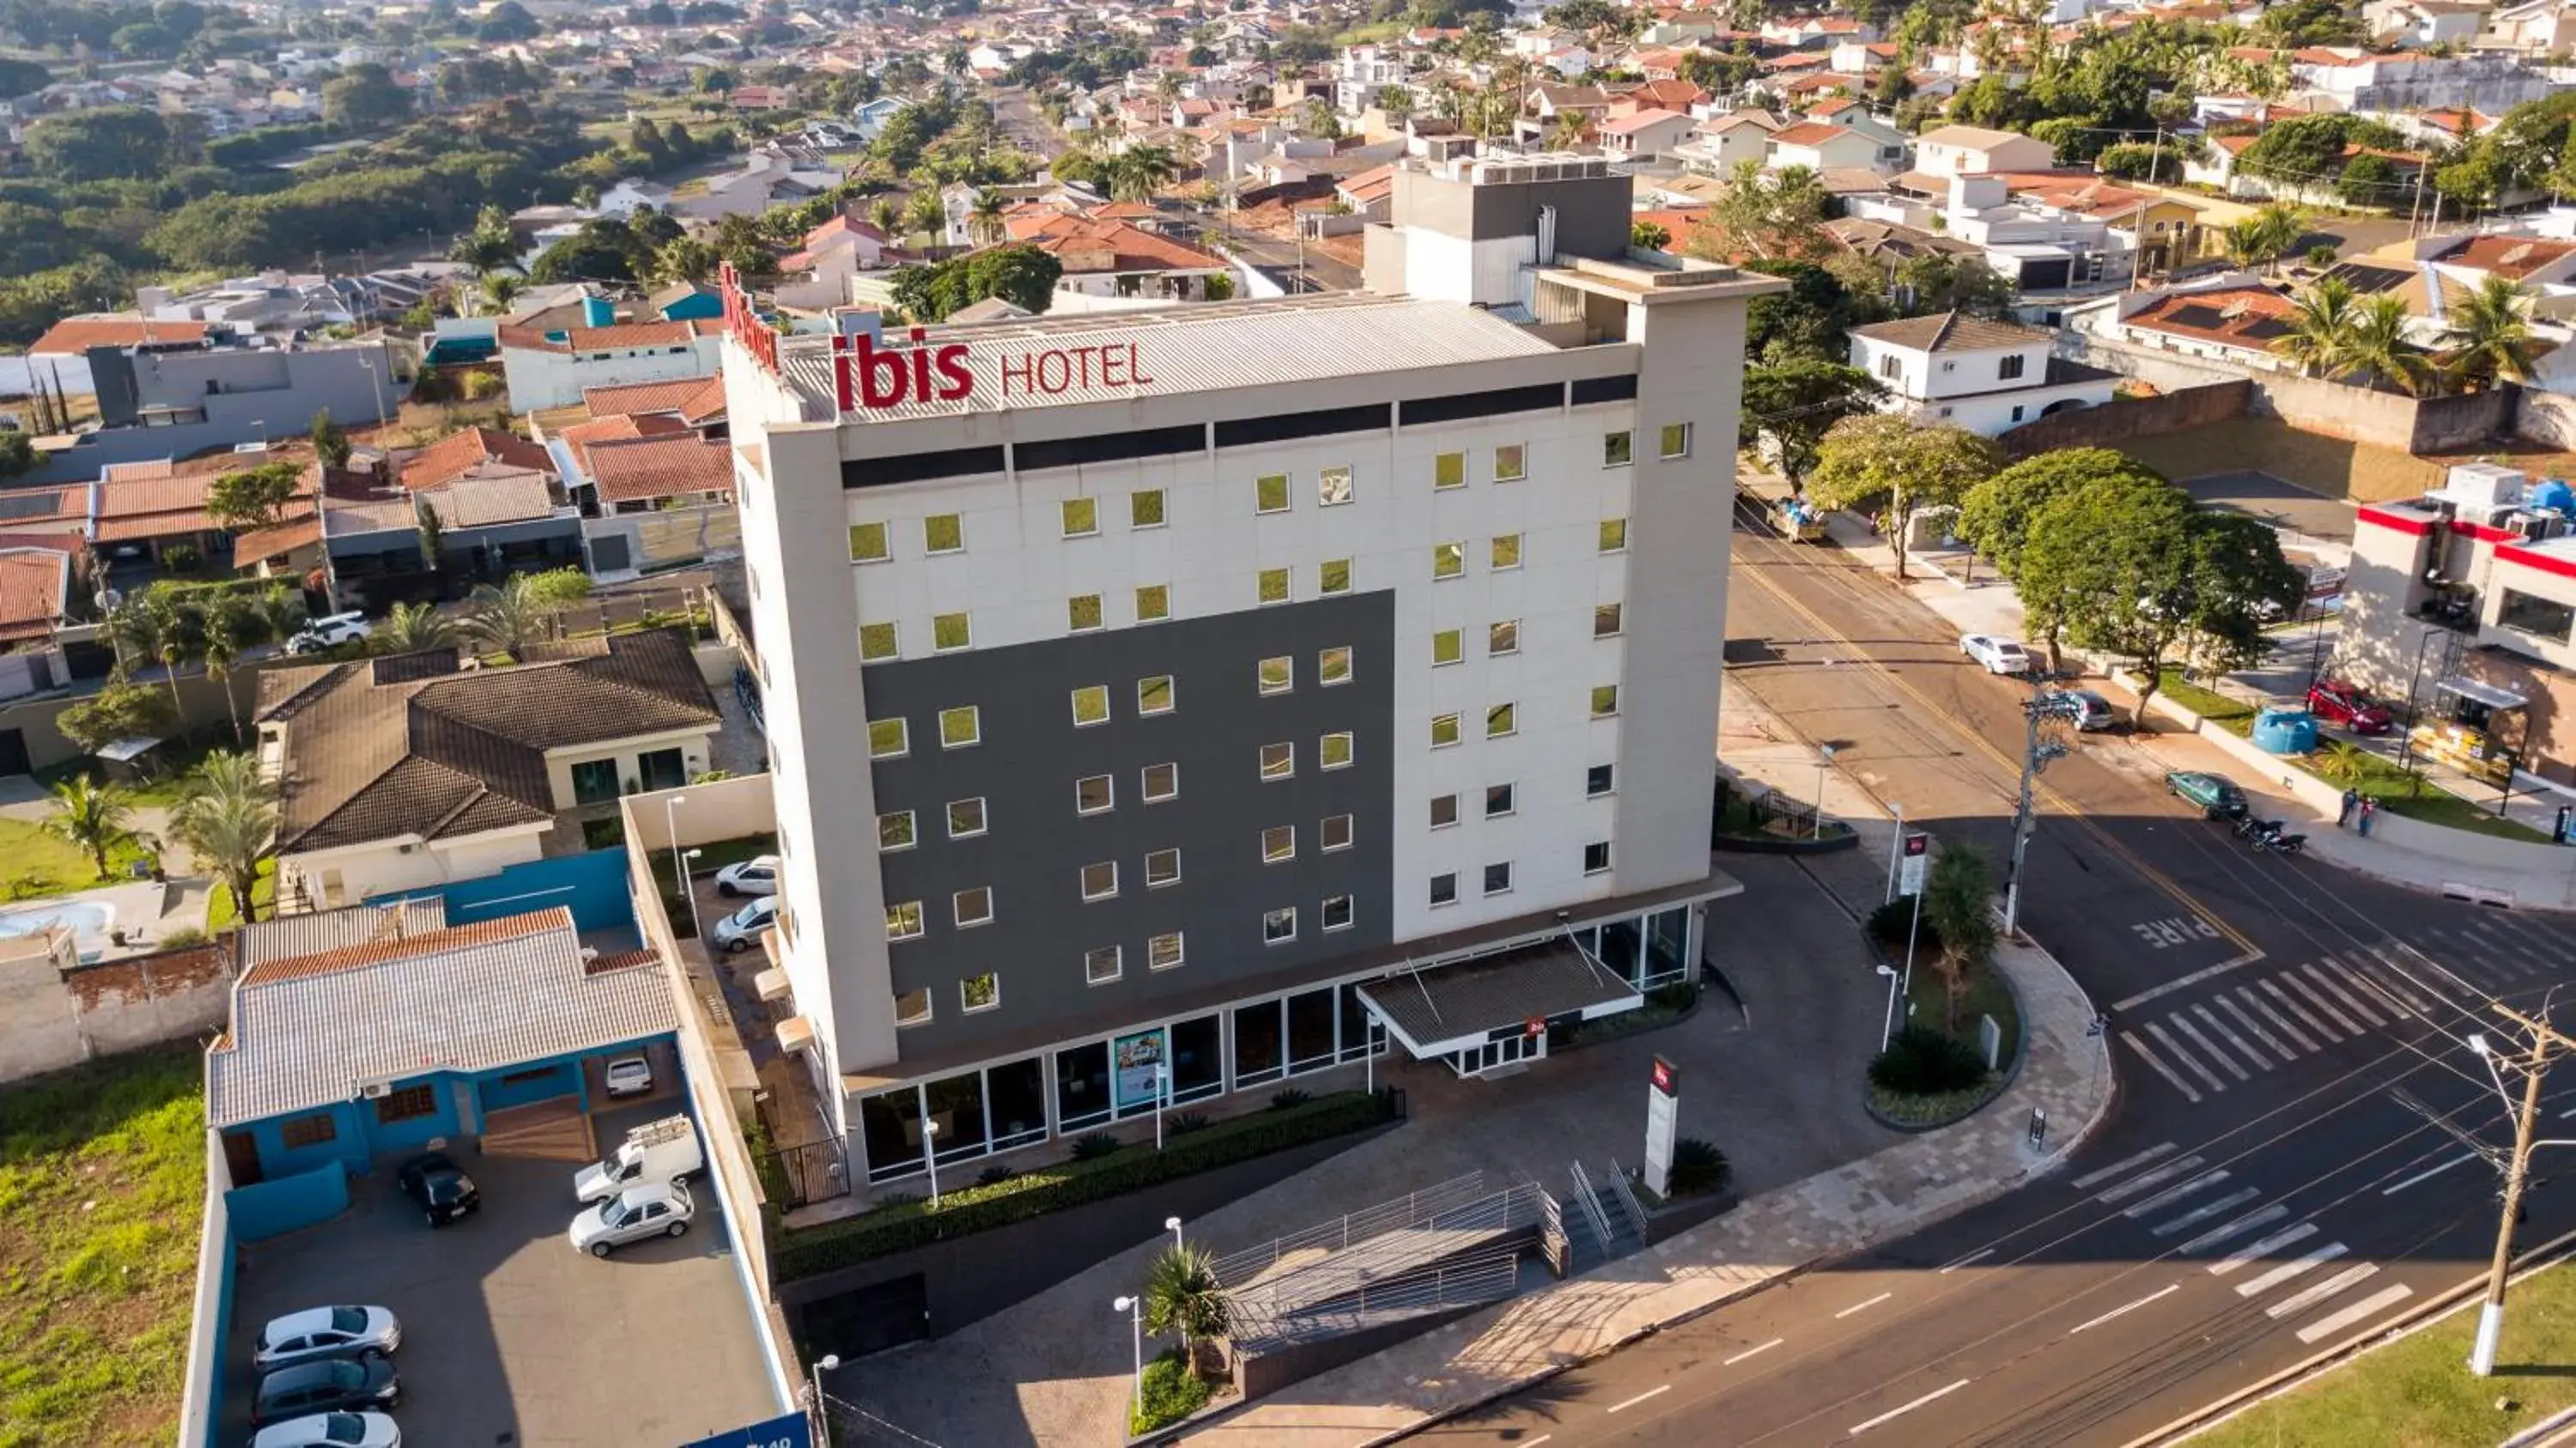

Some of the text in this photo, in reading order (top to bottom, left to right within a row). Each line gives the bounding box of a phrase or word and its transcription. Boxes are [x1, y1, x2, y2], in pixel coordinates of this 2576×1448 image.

[831, 327, 1153, 411] ibis HOTEL
[2130, 914, 2221, 948] PARE
